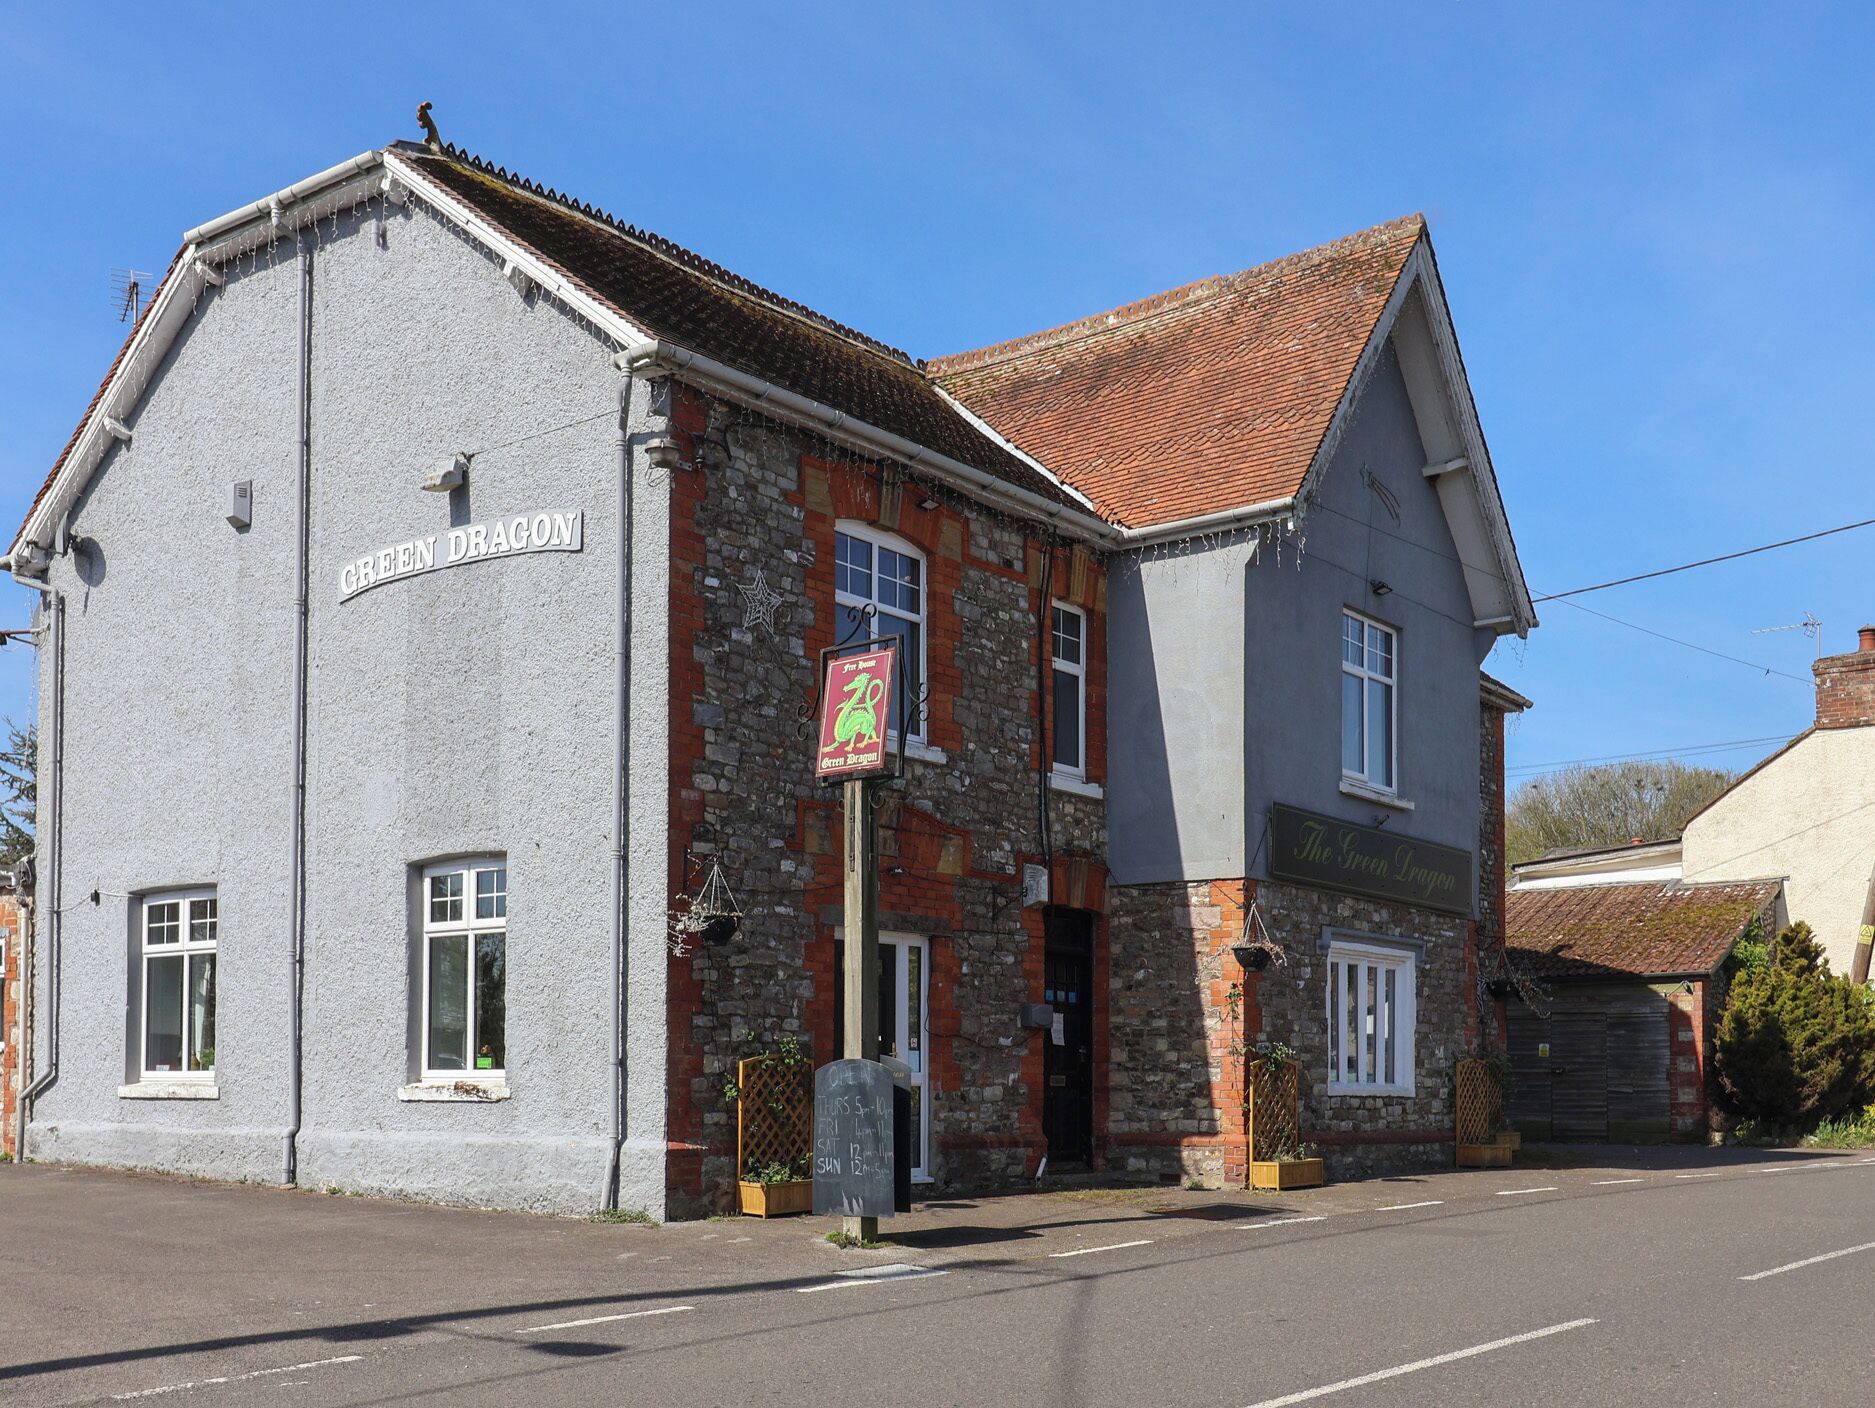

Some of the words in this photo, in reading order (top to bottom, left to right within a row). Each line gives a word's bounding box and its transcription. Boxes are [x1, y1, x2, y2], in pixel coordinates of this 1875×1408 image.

[340, 536, 437, 595] GREEN
[447, 512, 577, 563] DRAGON
[842, 663, 857, 674] Free
[857, 660, 876, 671] House
[821, 757, 845, 769] Green
[846, 752, 878, 765] Dragon
[1293, 820, 1334, 864] The
[1337, 830, 1388, 878] Green
[1393, 845, 1456, 897] Dragon
[817, 1095, 850, 1116] THURS
[818, 1117, 838, 1136] FRI
[817, 1137, 840, 1157] SAT
[816, 1157, 841, 1175] SUN
